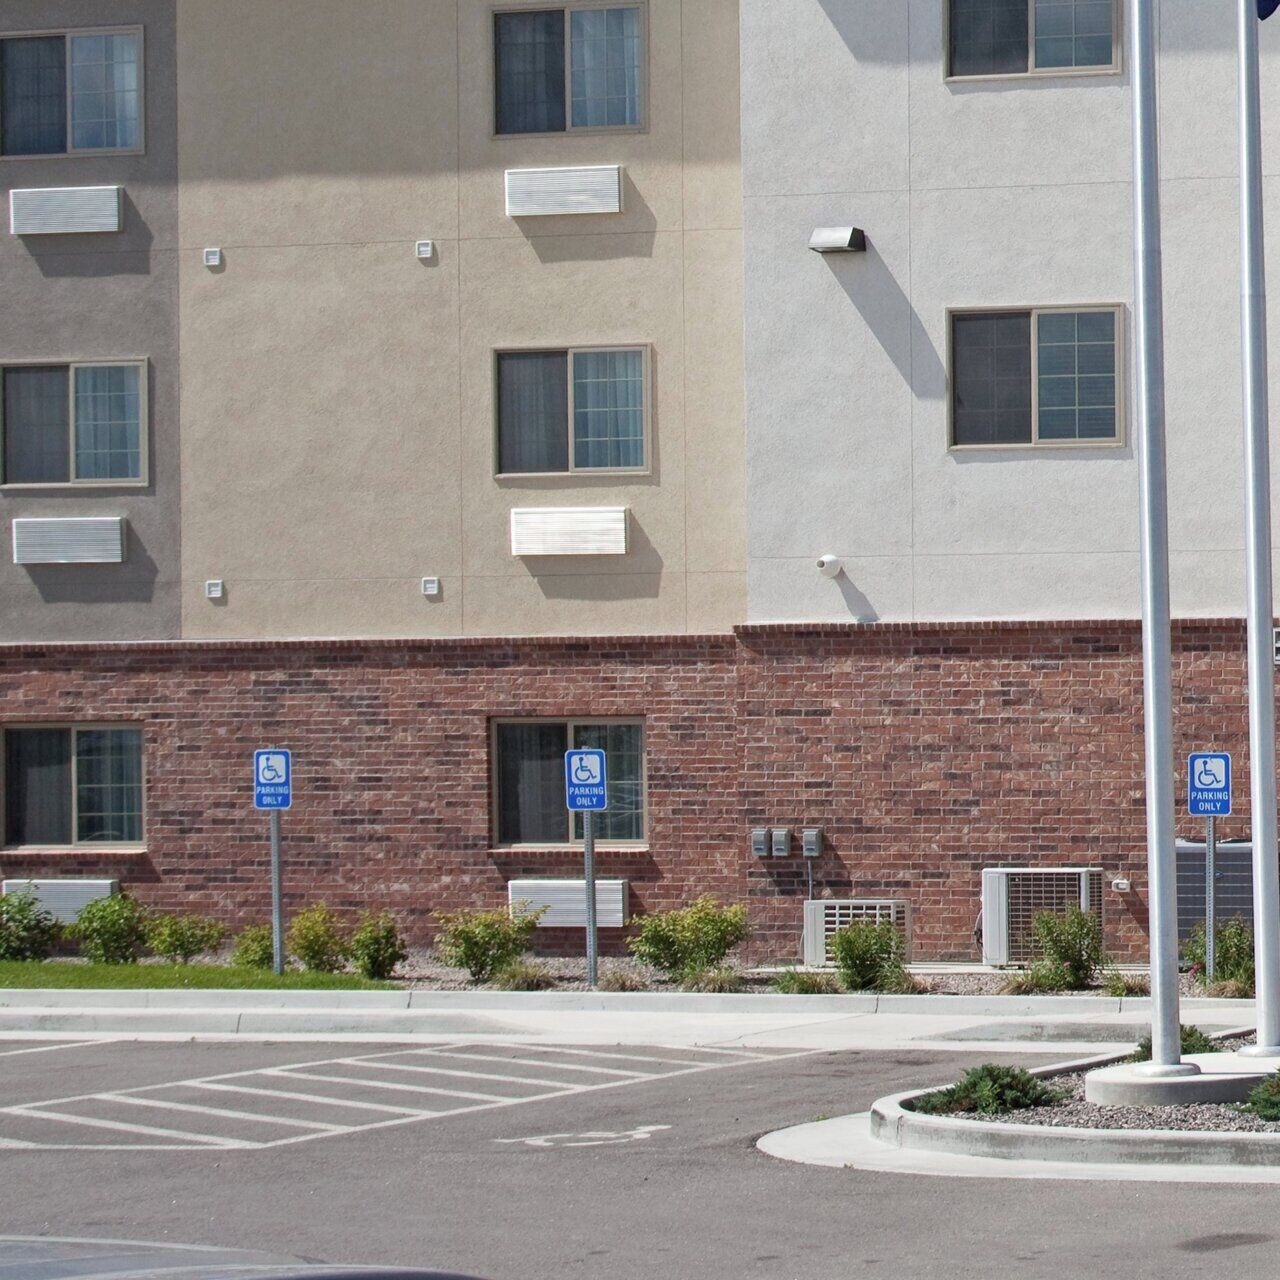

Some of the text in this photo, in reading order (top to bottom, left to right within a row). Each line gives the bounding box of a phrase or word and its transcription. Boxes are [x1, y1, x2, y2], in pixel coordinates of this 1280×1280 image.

[256, 786, 289, 794] PARKING
[569, 786, 604, 795] PARKING
[1191, 791, 1229, 800] PARKING
[262, 796, 283, 805] ONLY
[576, 797, 598, 806] ONLY
[1198, 802, 1222, 811] ONLY
